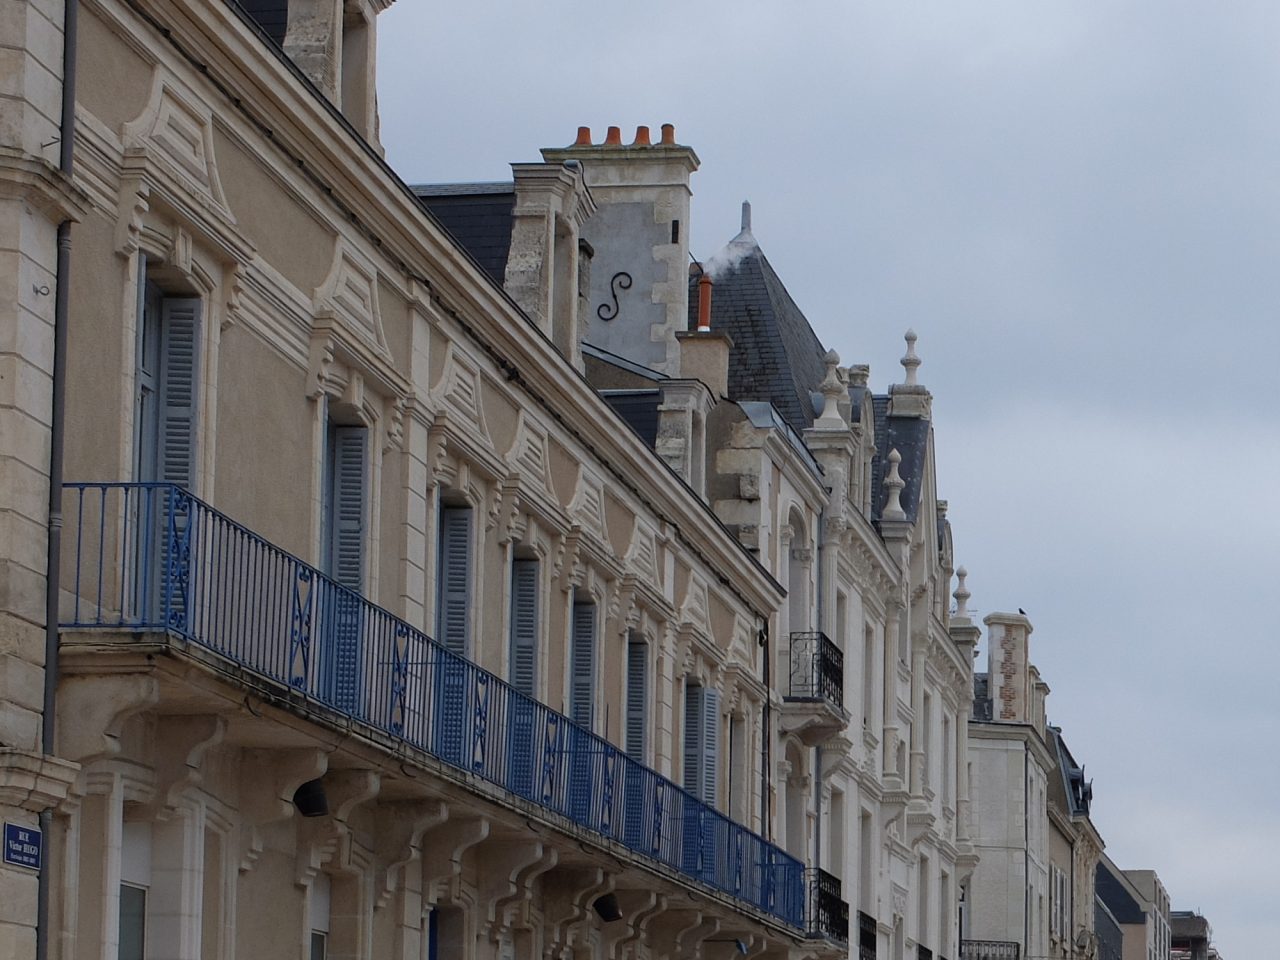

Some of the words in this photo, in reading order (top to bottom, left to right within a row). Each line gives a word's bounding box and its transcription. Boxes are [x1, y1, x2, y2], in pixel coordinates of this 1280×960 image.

[18, 831, 29, 842] RUE
[9, 840, 22, 852] Victor
[23, 843, 38, 856] HUGO
